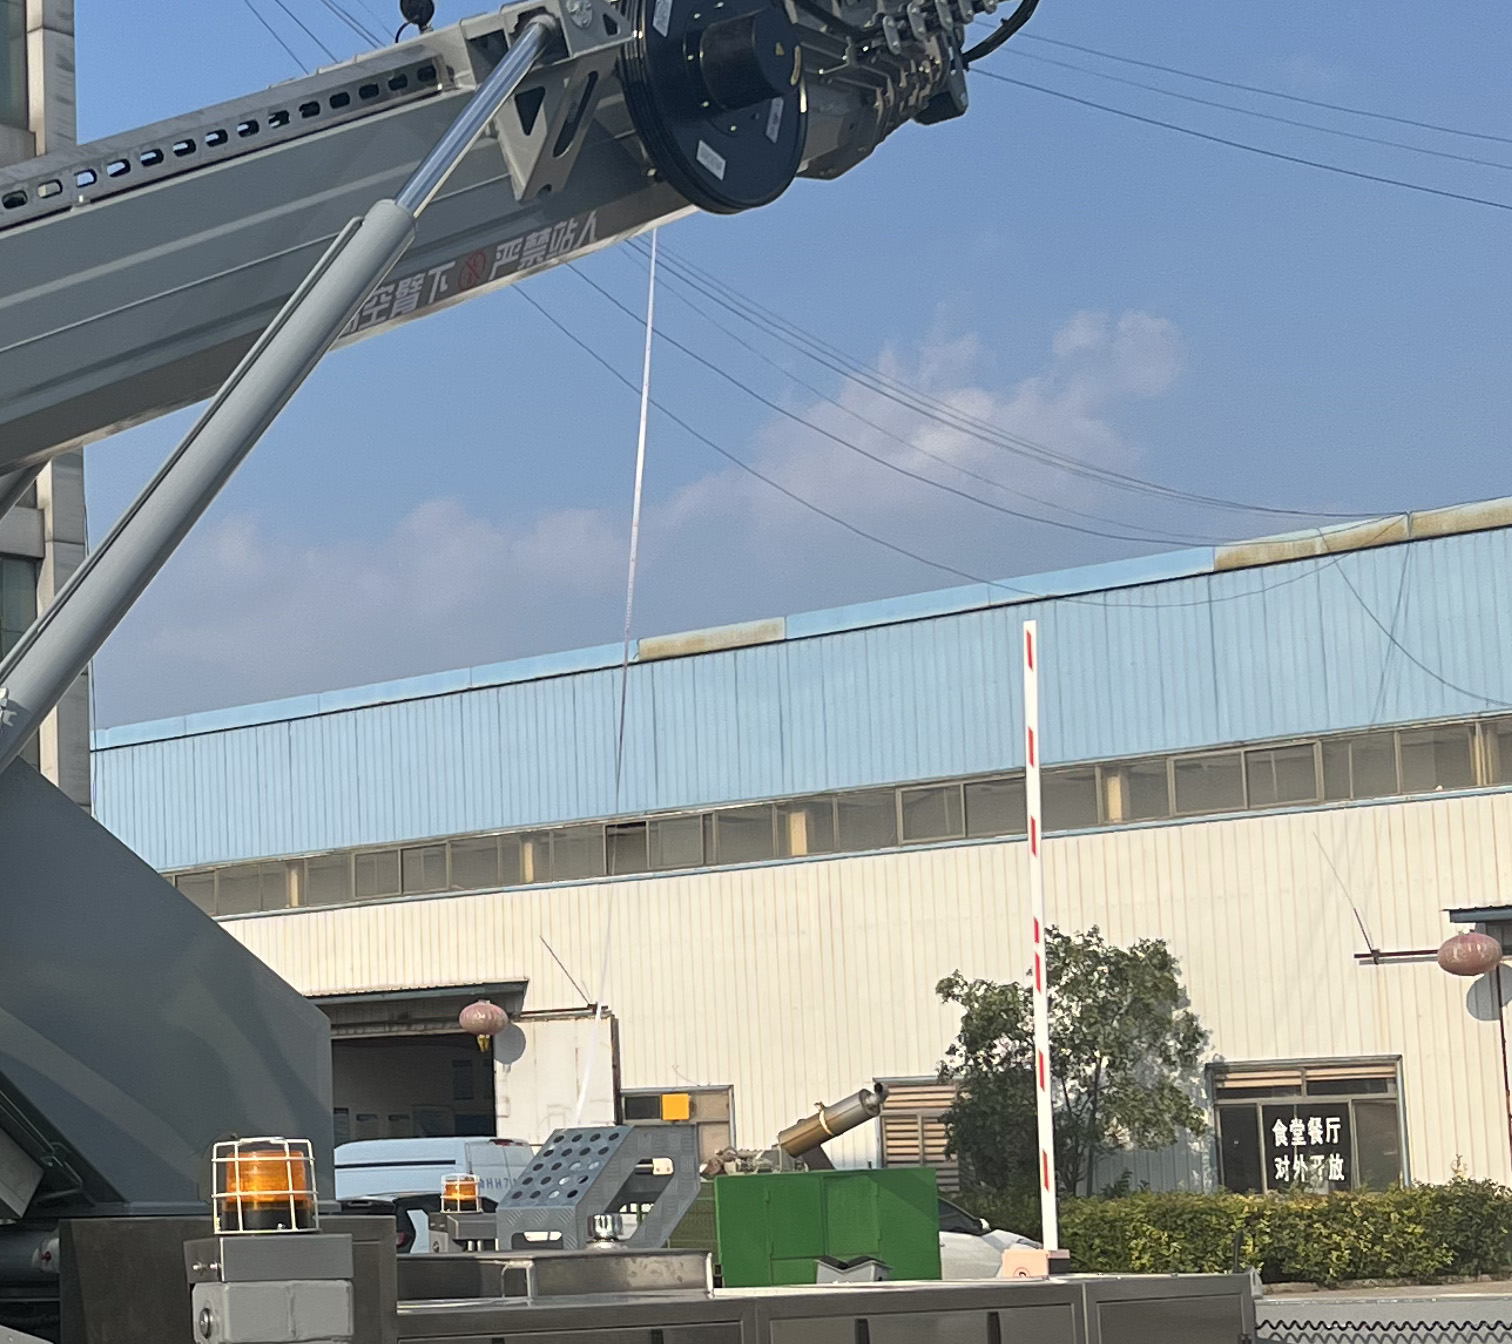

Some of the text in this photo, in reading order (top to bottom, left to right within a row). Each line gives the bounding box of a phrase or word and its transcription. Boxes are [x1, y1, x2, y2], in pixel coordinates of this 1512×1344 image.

[489, 210, 598, 281] 严禁站人
[1272, 1117, 1341, 1147] 食堂餐厅
[1274, 1153, 1345, 1182] 对外开放
